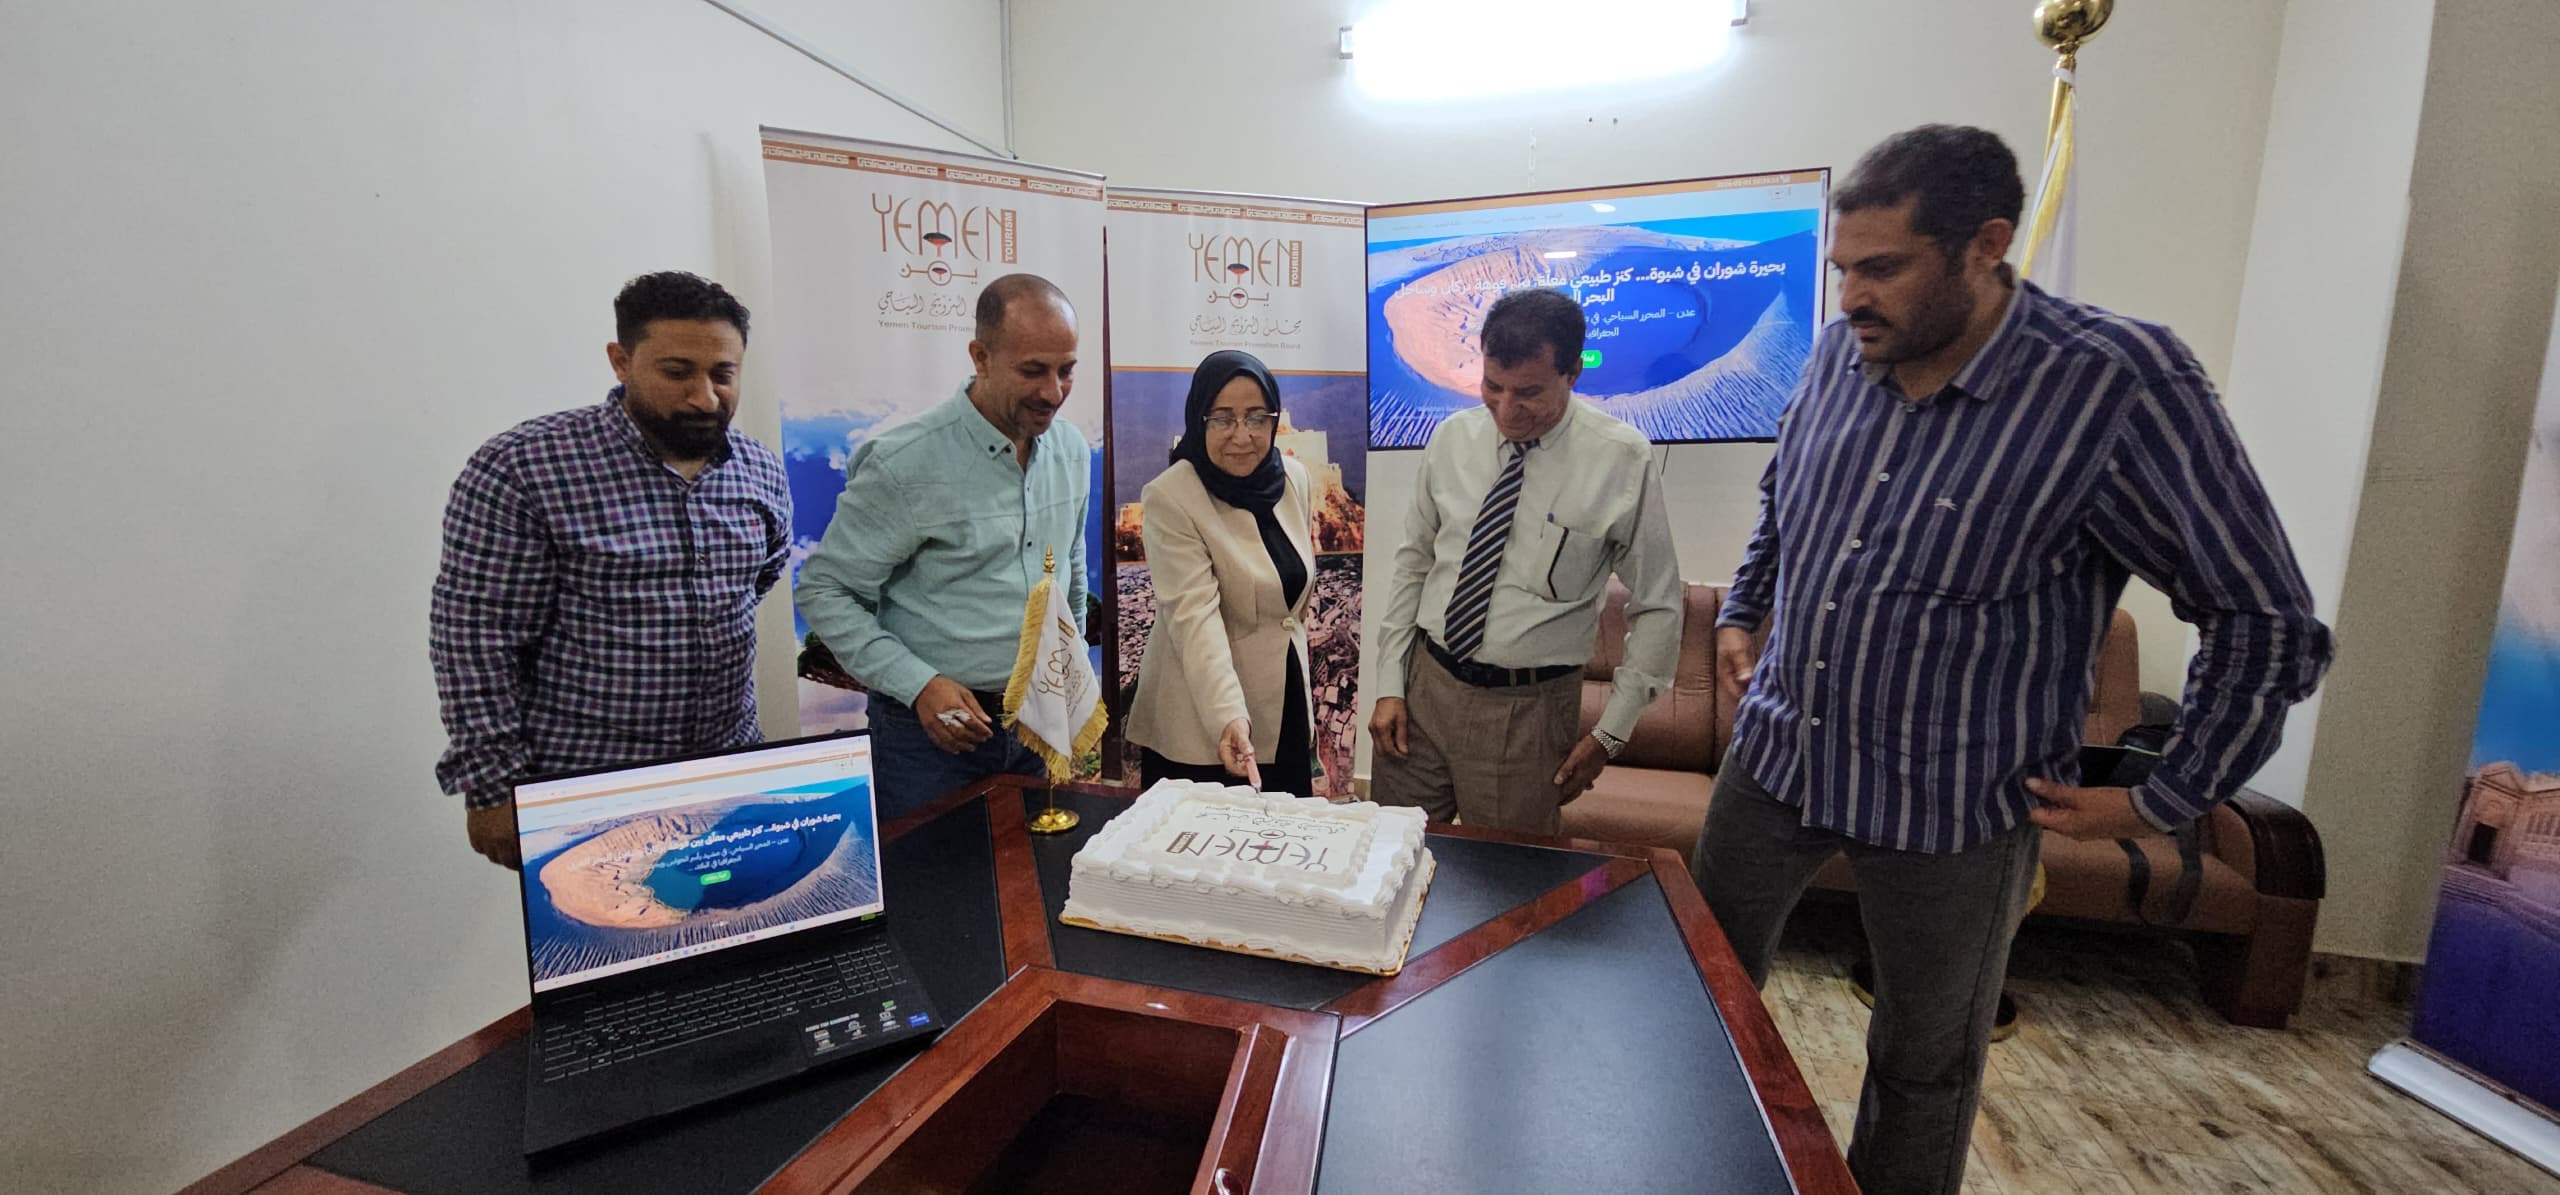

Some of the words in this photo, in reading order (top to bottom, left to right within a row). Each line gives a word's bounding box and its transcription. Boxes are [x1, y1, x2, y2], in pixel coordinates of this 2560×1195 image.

[872, 192, 1001, 262] YEMEN
[1003, 210, 1015, 263] TOURISM
[1188, 232, 1290, 287] YEMEN
[1749, 261, 1786, 276] بحيرة
[1570, 270, 1611, 289] طبيعي
[1613, 267, 1634, 286] كنز
[1687, 261, 1701, 285] في
[1704, 262, 1746, 281] شوران
[1583, 287, 1615, 307] البحر
[911, 322, 947, 331] Tourism
[1187, 834, 1328, 872] YEMEN
